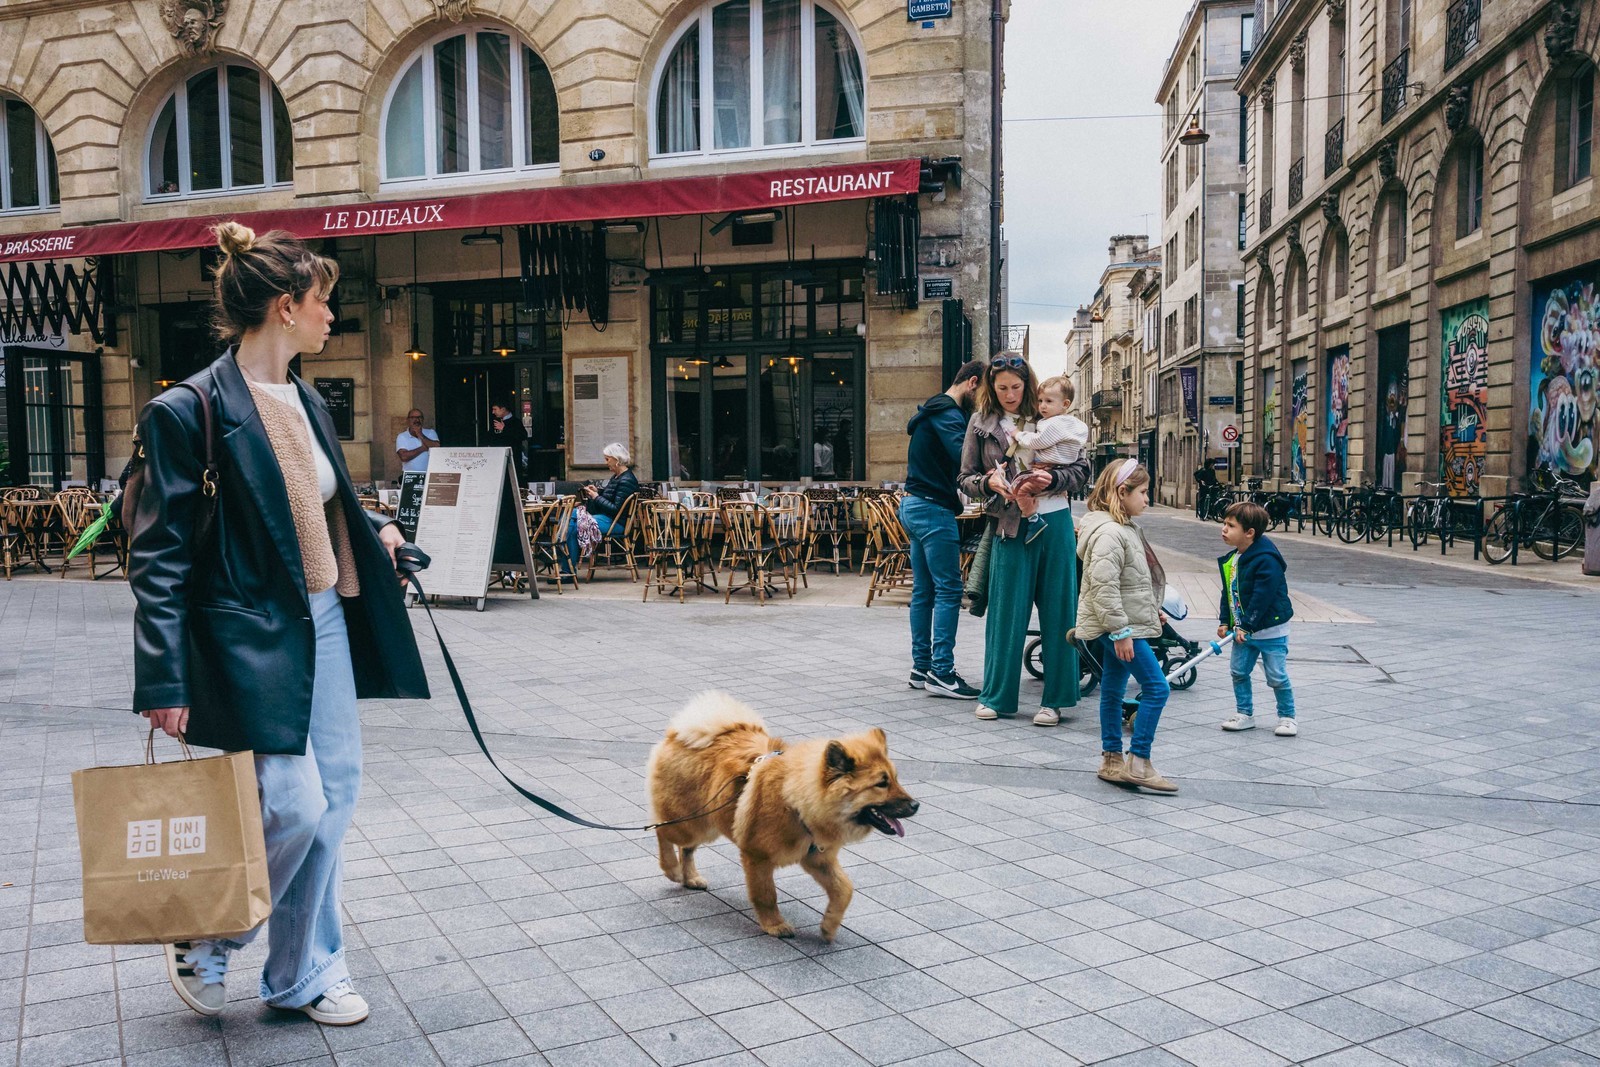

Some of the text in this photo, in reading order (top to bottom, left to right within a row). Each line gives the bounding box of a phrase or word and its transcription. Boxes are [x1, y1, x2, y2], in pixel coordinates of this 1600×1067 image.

[911, 3, 948, 13] GAMBETTA
[770, 171, 894, 198] RESTAURANT
[323, 204, 445, 230] LE DIJEAUX
[4, 236, 76, 255] BRASSERIE
[174, 821, 199, 835] UNI
[174, 836, 201, 851] QLO
[137, 868, 191, 882] LifeWear
